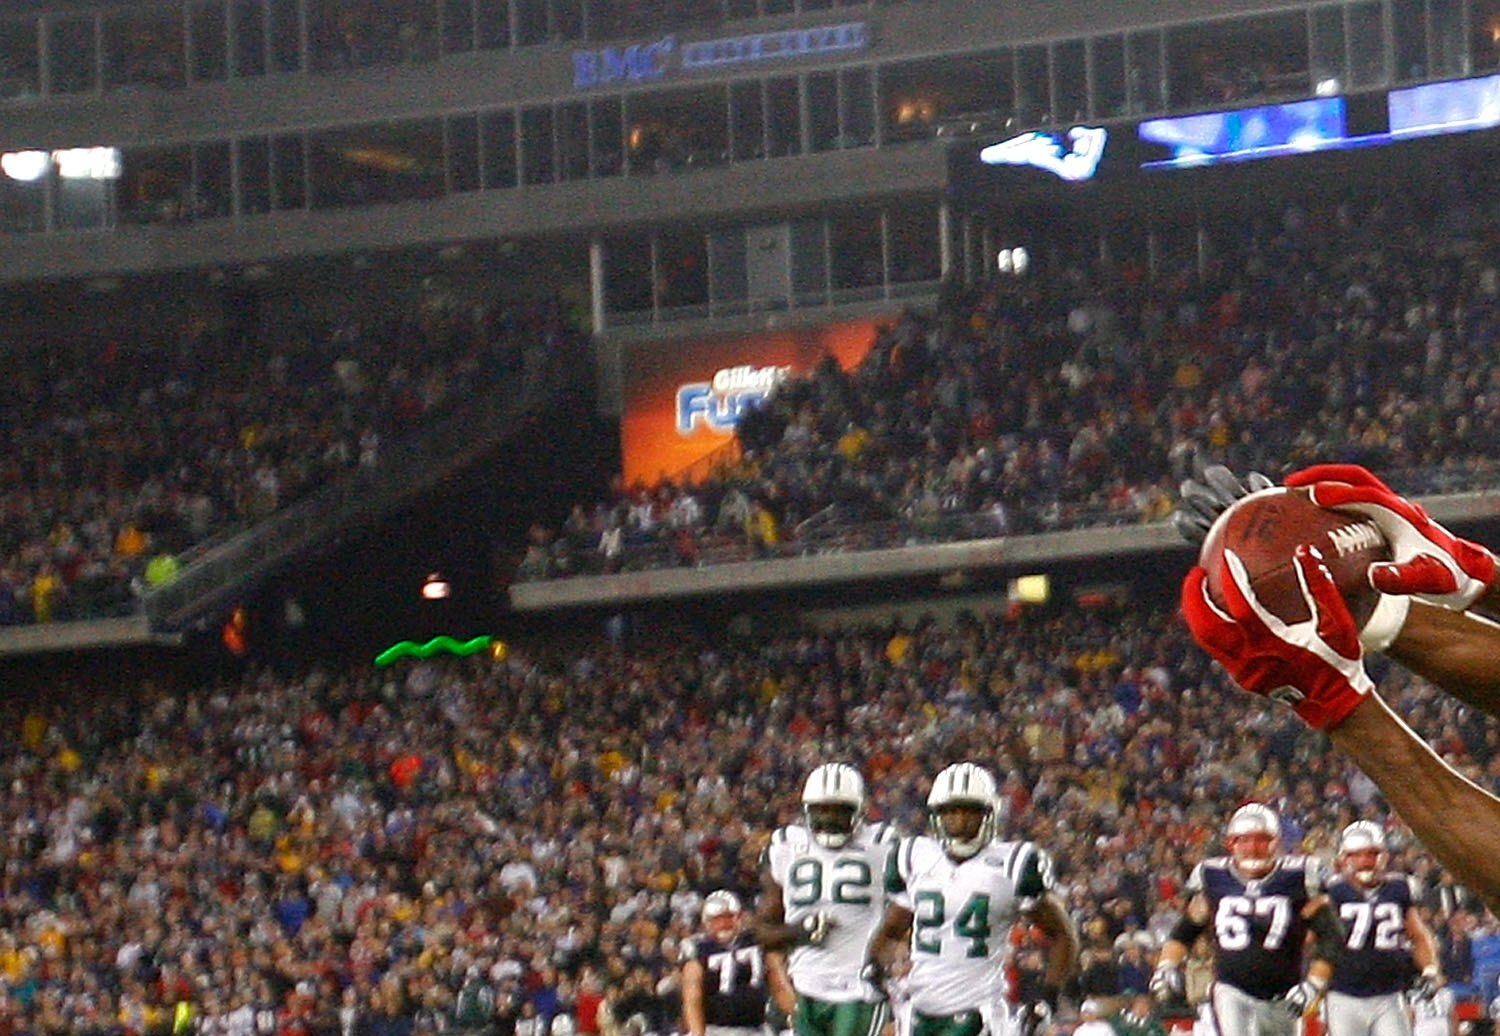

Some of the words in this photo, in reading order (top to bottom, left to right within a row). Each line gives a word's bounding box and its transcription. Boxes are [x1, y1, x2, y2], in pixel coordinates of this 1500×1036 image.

[788, 857, 873, 906] 92
[914, 890, 992, 959] 24
[1214, 895, 1290, 950] 67
[1340, 901, 1402, 950] 72
[708, 945, 763, 994] 77
